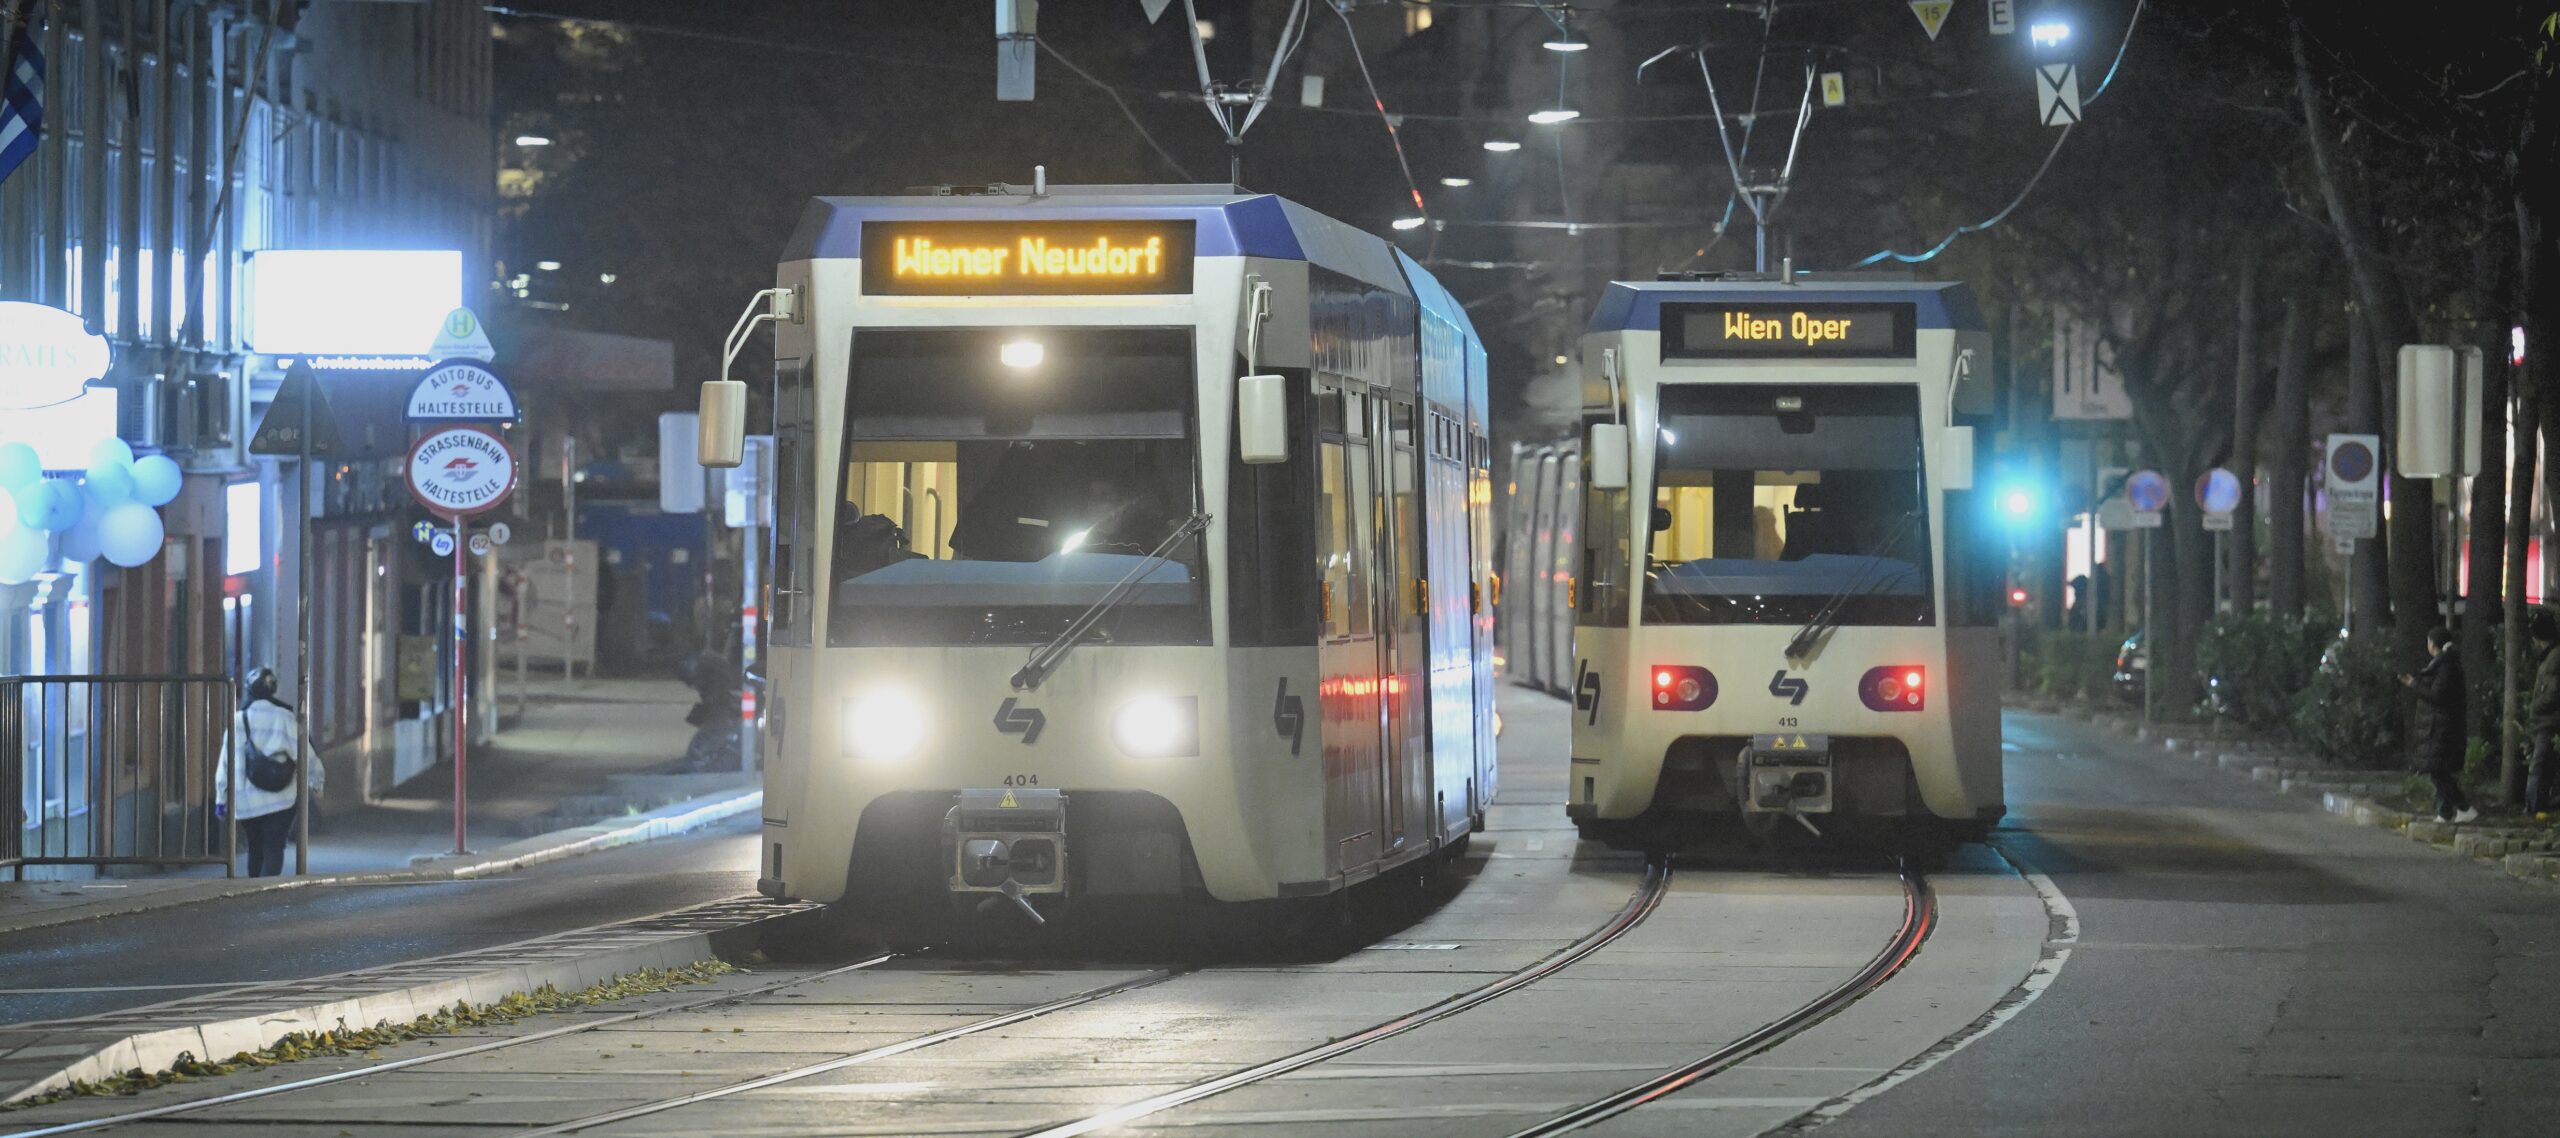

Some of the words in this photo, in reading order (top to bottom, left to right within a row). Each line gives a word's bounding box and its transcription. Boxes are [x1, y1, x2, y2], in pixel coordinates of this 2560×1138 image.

[1923, 6, 1941, 21] 15
[1992, 1, 2009, 25] E
[1827, 79, 1839, 93] A
[895, 237, 1008, 275] Wiener
[1019, 236, 1161, 275] Neudorf
[452, 314, 468, 333] H
[1724, 312, 1782, 340] Wien
[1791, 312, 1851, 346] Oper
[430, 369, 494, 391] AUTOBUS
[418, 402, 504, 415] HALTESTELLE
[418, 434, 505, 465] STRASSENBAHN
[422, 478, 501, 504] HALTESTELLE
[472, 538, 489, 550] 62
[1778, 717, 1798, 727] 413
[1003, 774, 1039, 787] 404
